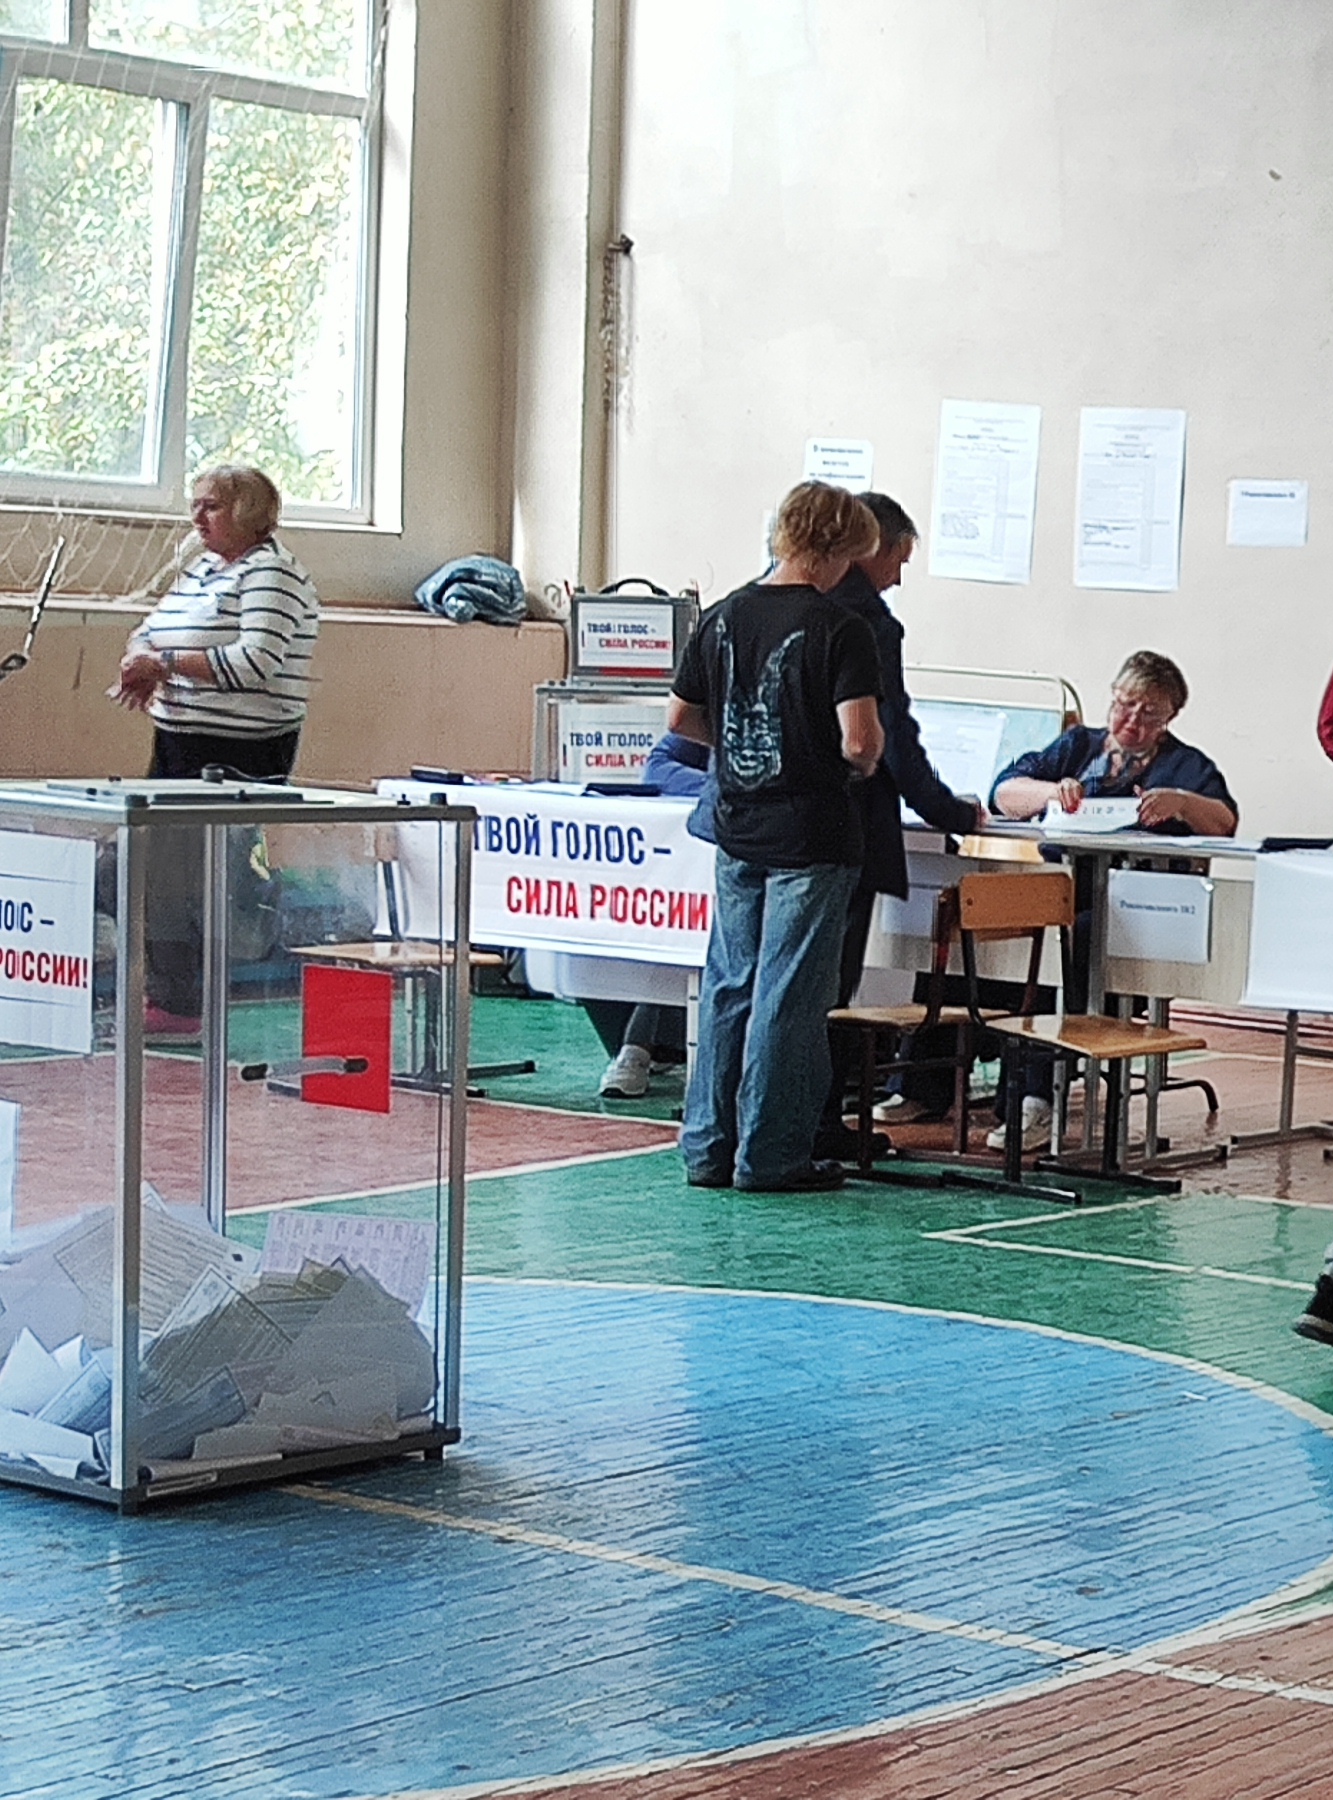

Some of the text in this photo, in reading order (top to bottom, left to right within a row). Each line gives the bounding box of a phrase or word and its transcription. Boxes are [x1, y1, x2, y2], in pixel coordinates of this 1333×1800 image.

[587, 622, 612, 633] ТВОЙ
[617, 624, 648, 635] ГОЛОС
[598, 638, 628, 649] СИЛА
[570, 731, 654, 748] ТВОЙ ГОЛОС
[585, 753, 626, 768] СИЛА
[551, 820, 645, 865] ГОЛОС
[506, 876, 716, 931] СИЛА РОССИИ
[0, 899, 33, 933] ОС
